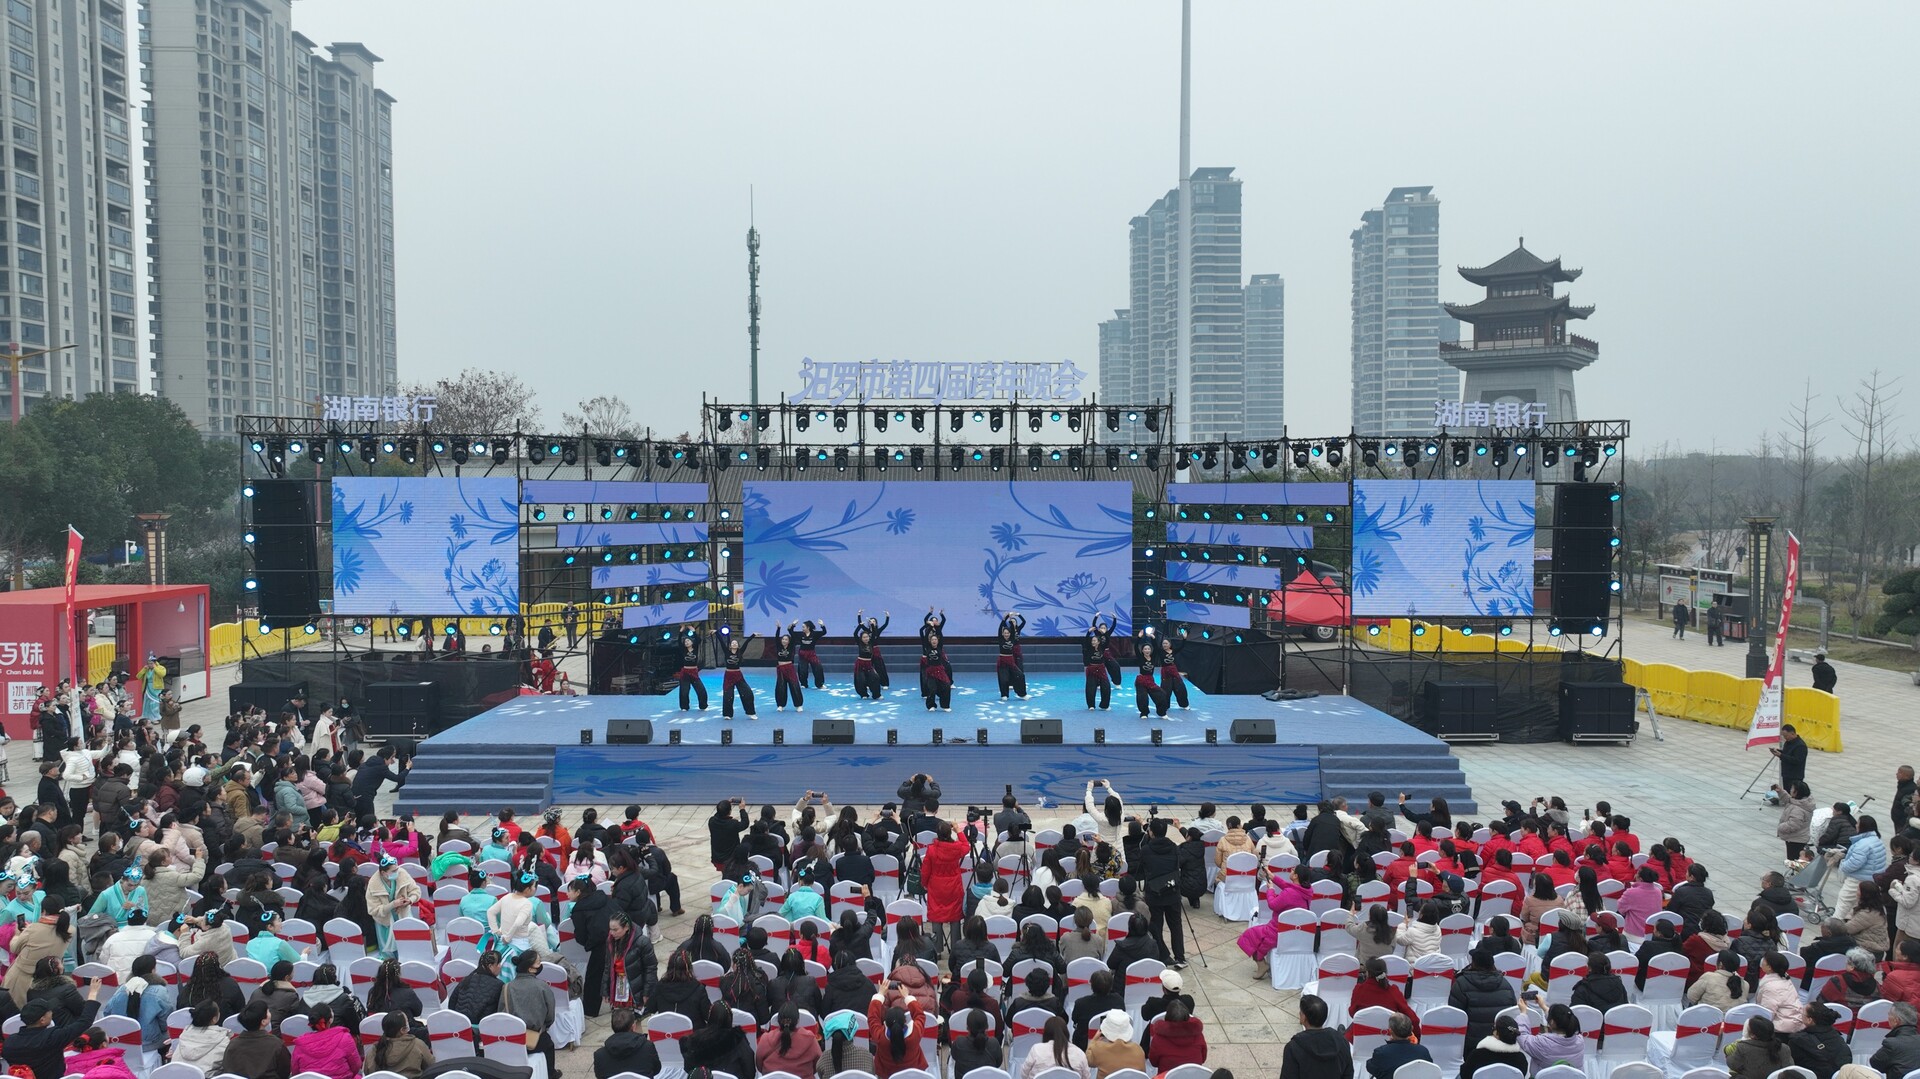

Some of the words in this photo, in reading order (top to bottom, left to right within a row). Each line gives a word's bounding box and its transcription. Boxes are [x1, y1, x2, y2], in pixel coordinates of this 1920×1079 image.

[788, 357, 1088, 405] 汨罗市第四届跨年晚会
[323, 395, 437, 422] 湖南银行
[1434, 401, 1548, 429] 湖南银行
